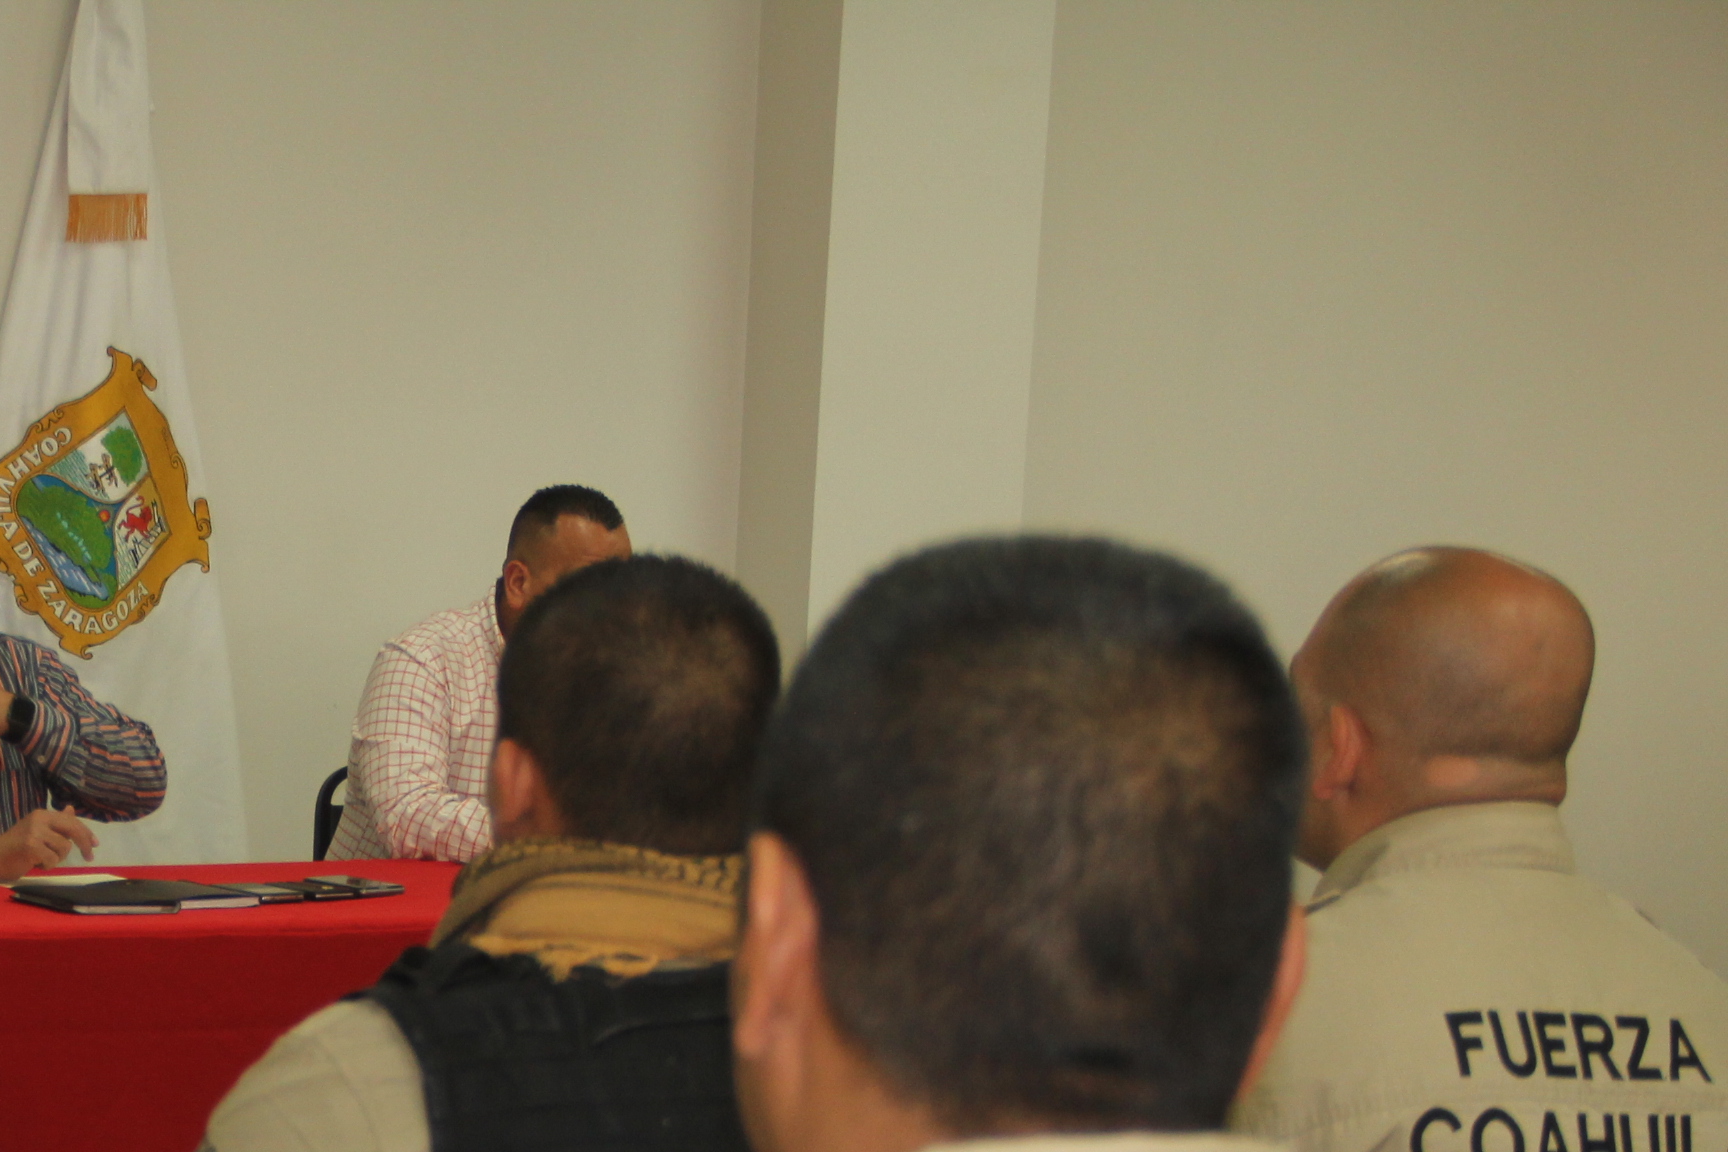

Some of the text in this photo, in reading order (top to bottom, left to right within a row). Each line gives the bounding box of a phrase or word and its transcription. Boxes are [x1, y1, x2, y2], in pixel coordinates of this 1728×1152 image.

[15, 541, 47, 578] DE
[37, 580, 150, 635] ZARAGOZA
[1443, 1008, 1715, 1084] FUERZA
